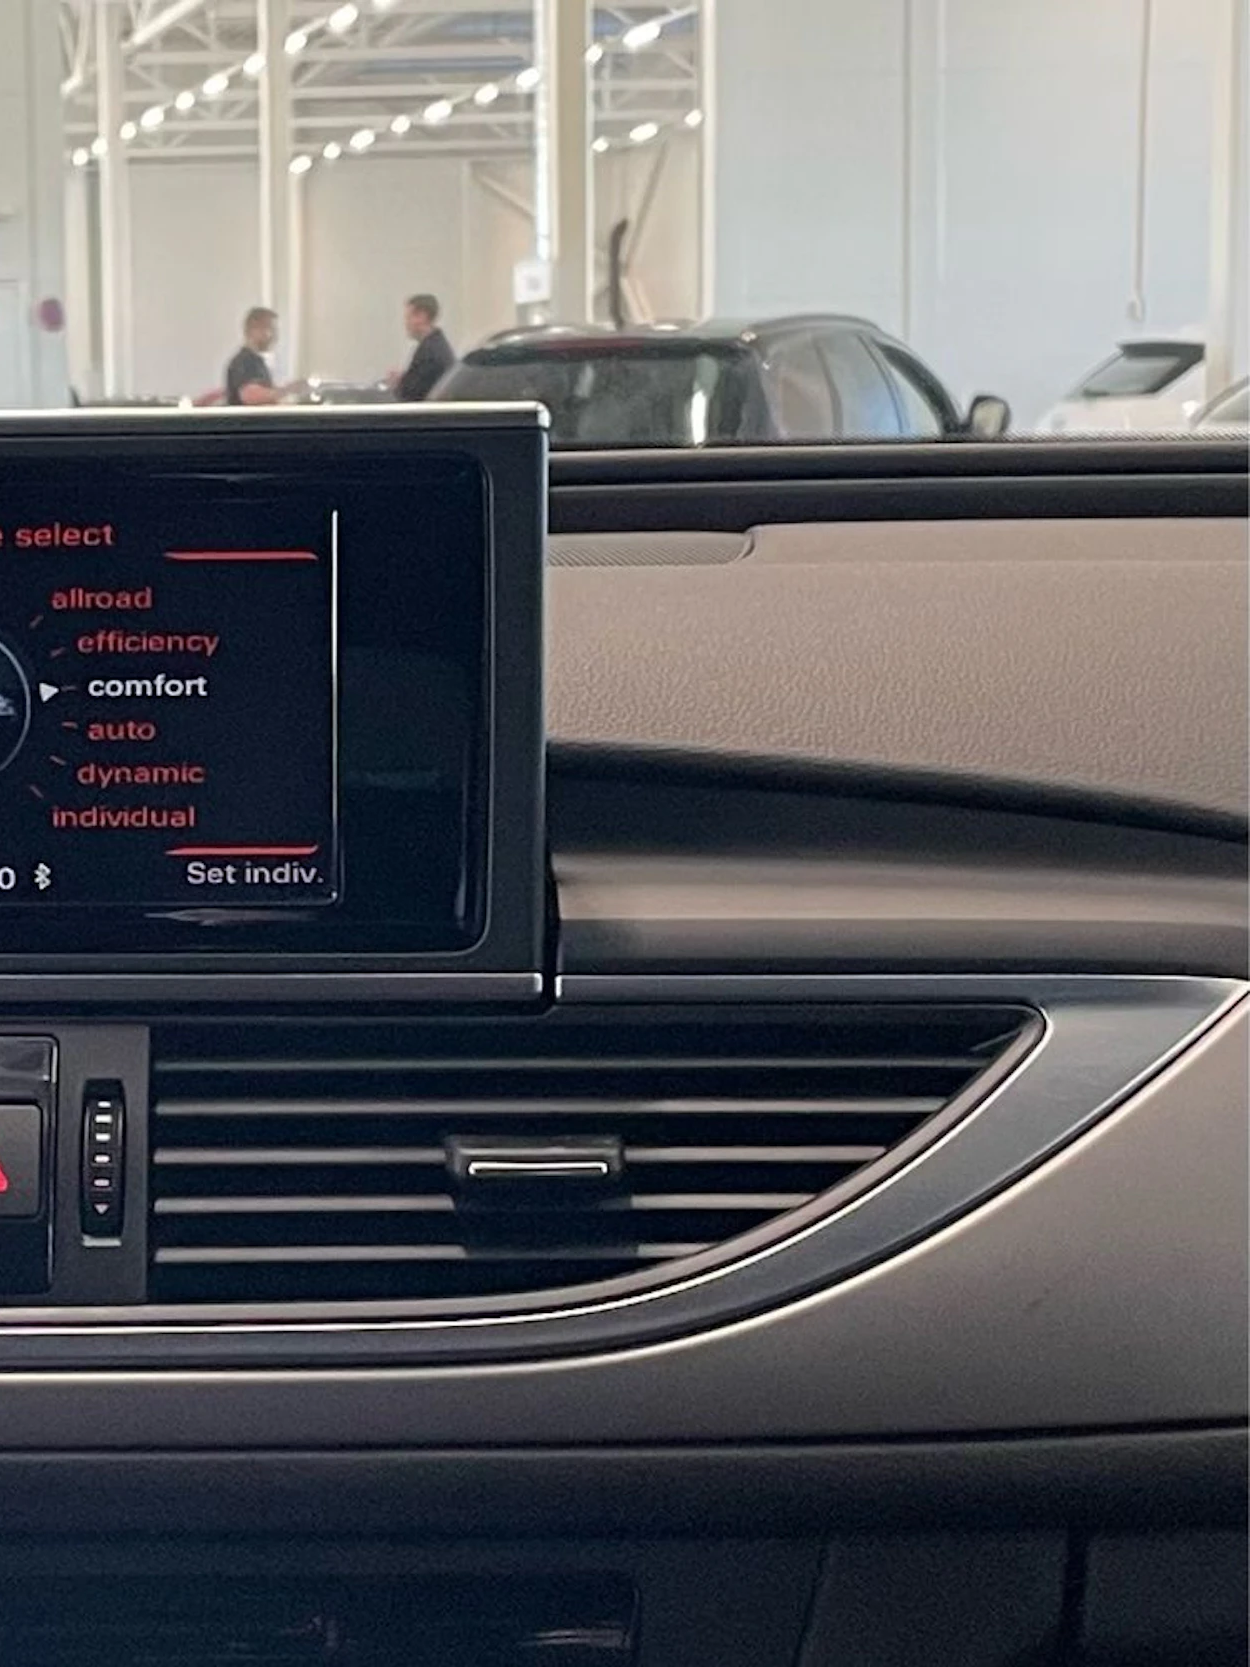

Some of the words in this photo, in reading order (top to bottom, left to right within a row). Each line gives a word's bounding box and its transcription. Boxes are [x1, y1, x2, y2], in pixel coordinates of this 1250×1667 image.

[15, 523, 114, 547] select
[52, 587, 152, 610] allroad
[77, 630, 219, 657] efficiency
[88, 673, 208, 697] comfort
[88, 721, 155, 741] auto
[77, 763, 204, 787] dynamic
[53, 806, 195, 828] individual
[187, 861, 236, 885] Set
[245, 861, 323, 884] indiv.
